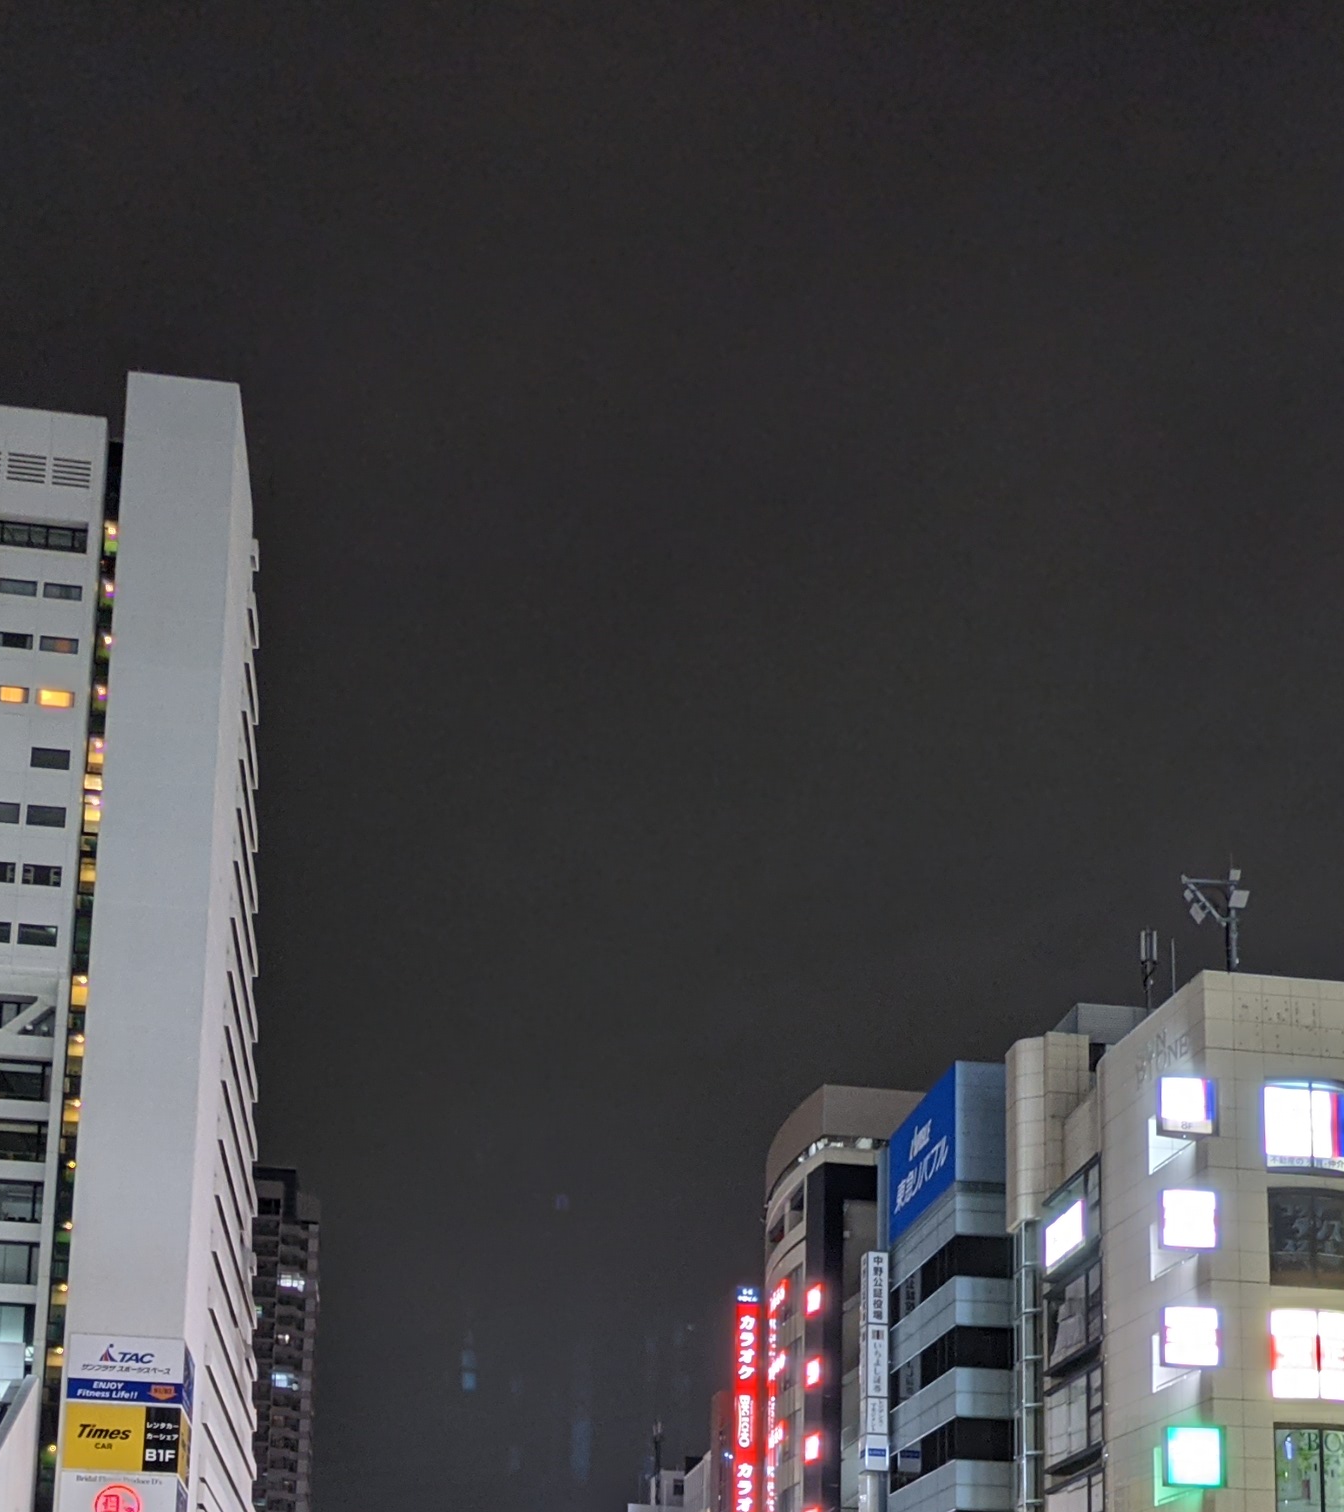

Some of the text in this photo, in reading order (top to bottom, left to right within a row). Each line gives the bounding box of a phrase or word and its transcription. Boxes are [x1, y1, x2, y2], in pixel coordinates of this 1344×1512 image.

[738, 1314, 756, 1380] カラオケ
[117, 1351, 155, 1364] TAC
[92, 1380, 124, 1390] ENJOY
[76, 1388, 138, 1400] Fitness Life!!
[146, 1421, 179, 1430] レンタカー
[77, 1423, 132, 1441] Times
[146, 1432, 178, 1441] カーシェア
[94, 1442, 113, 1450] CAR
[145, 1448, 175, 1462] B1F
